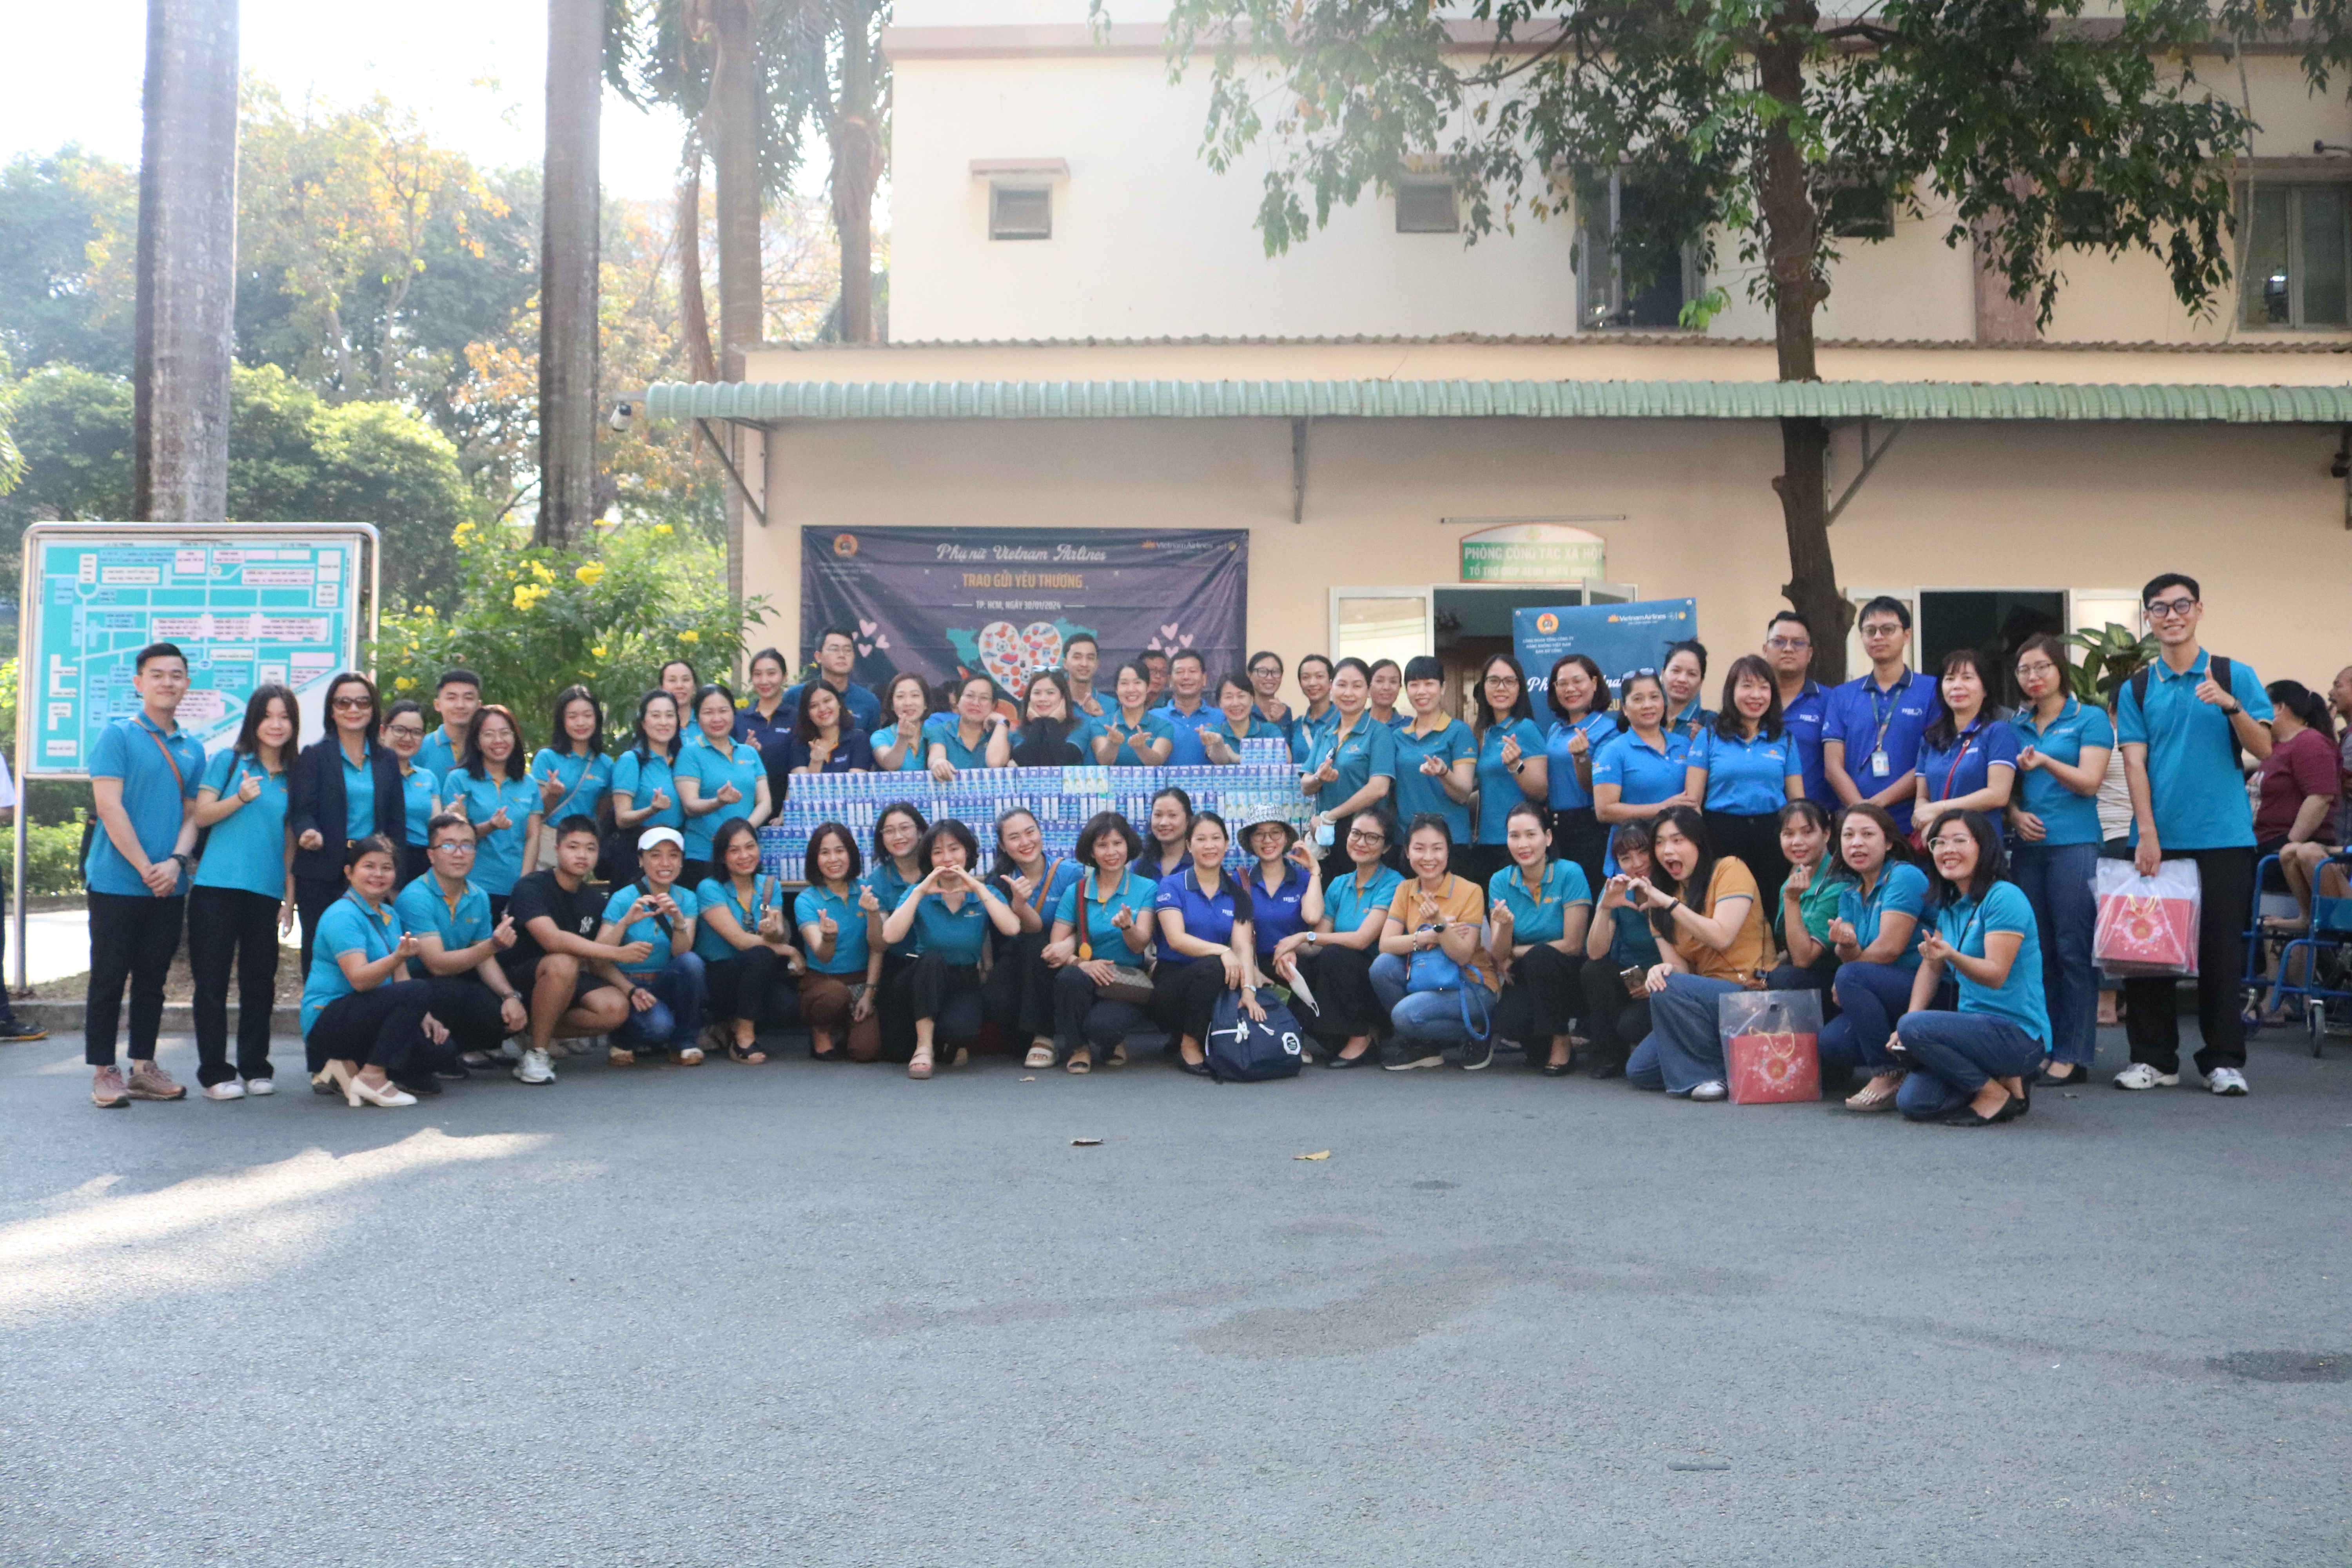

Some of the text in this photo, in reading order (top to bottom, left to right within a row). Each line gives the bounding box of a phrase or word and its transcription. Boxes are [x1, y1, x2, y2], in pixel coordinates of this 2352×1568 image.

[937, 543, 1106, 563] Phụ nữ Vietnam Airlines
[1465, 544, 1502, 559] PHÒNG
[1505, 544, 1536, 559] CÔNG
[1539, 544, 1561, 559] TÁC
[1564, 544, 1579, 559] XÃ
[963, 569, 1083, 588] TRAO GỬI YÊU THƯƠNG
[1483, 566, 1498, 577] TRỢ
[1005, 599, 1024, 609] NGÀY
[1527, 676, 1548, 692] Ph
